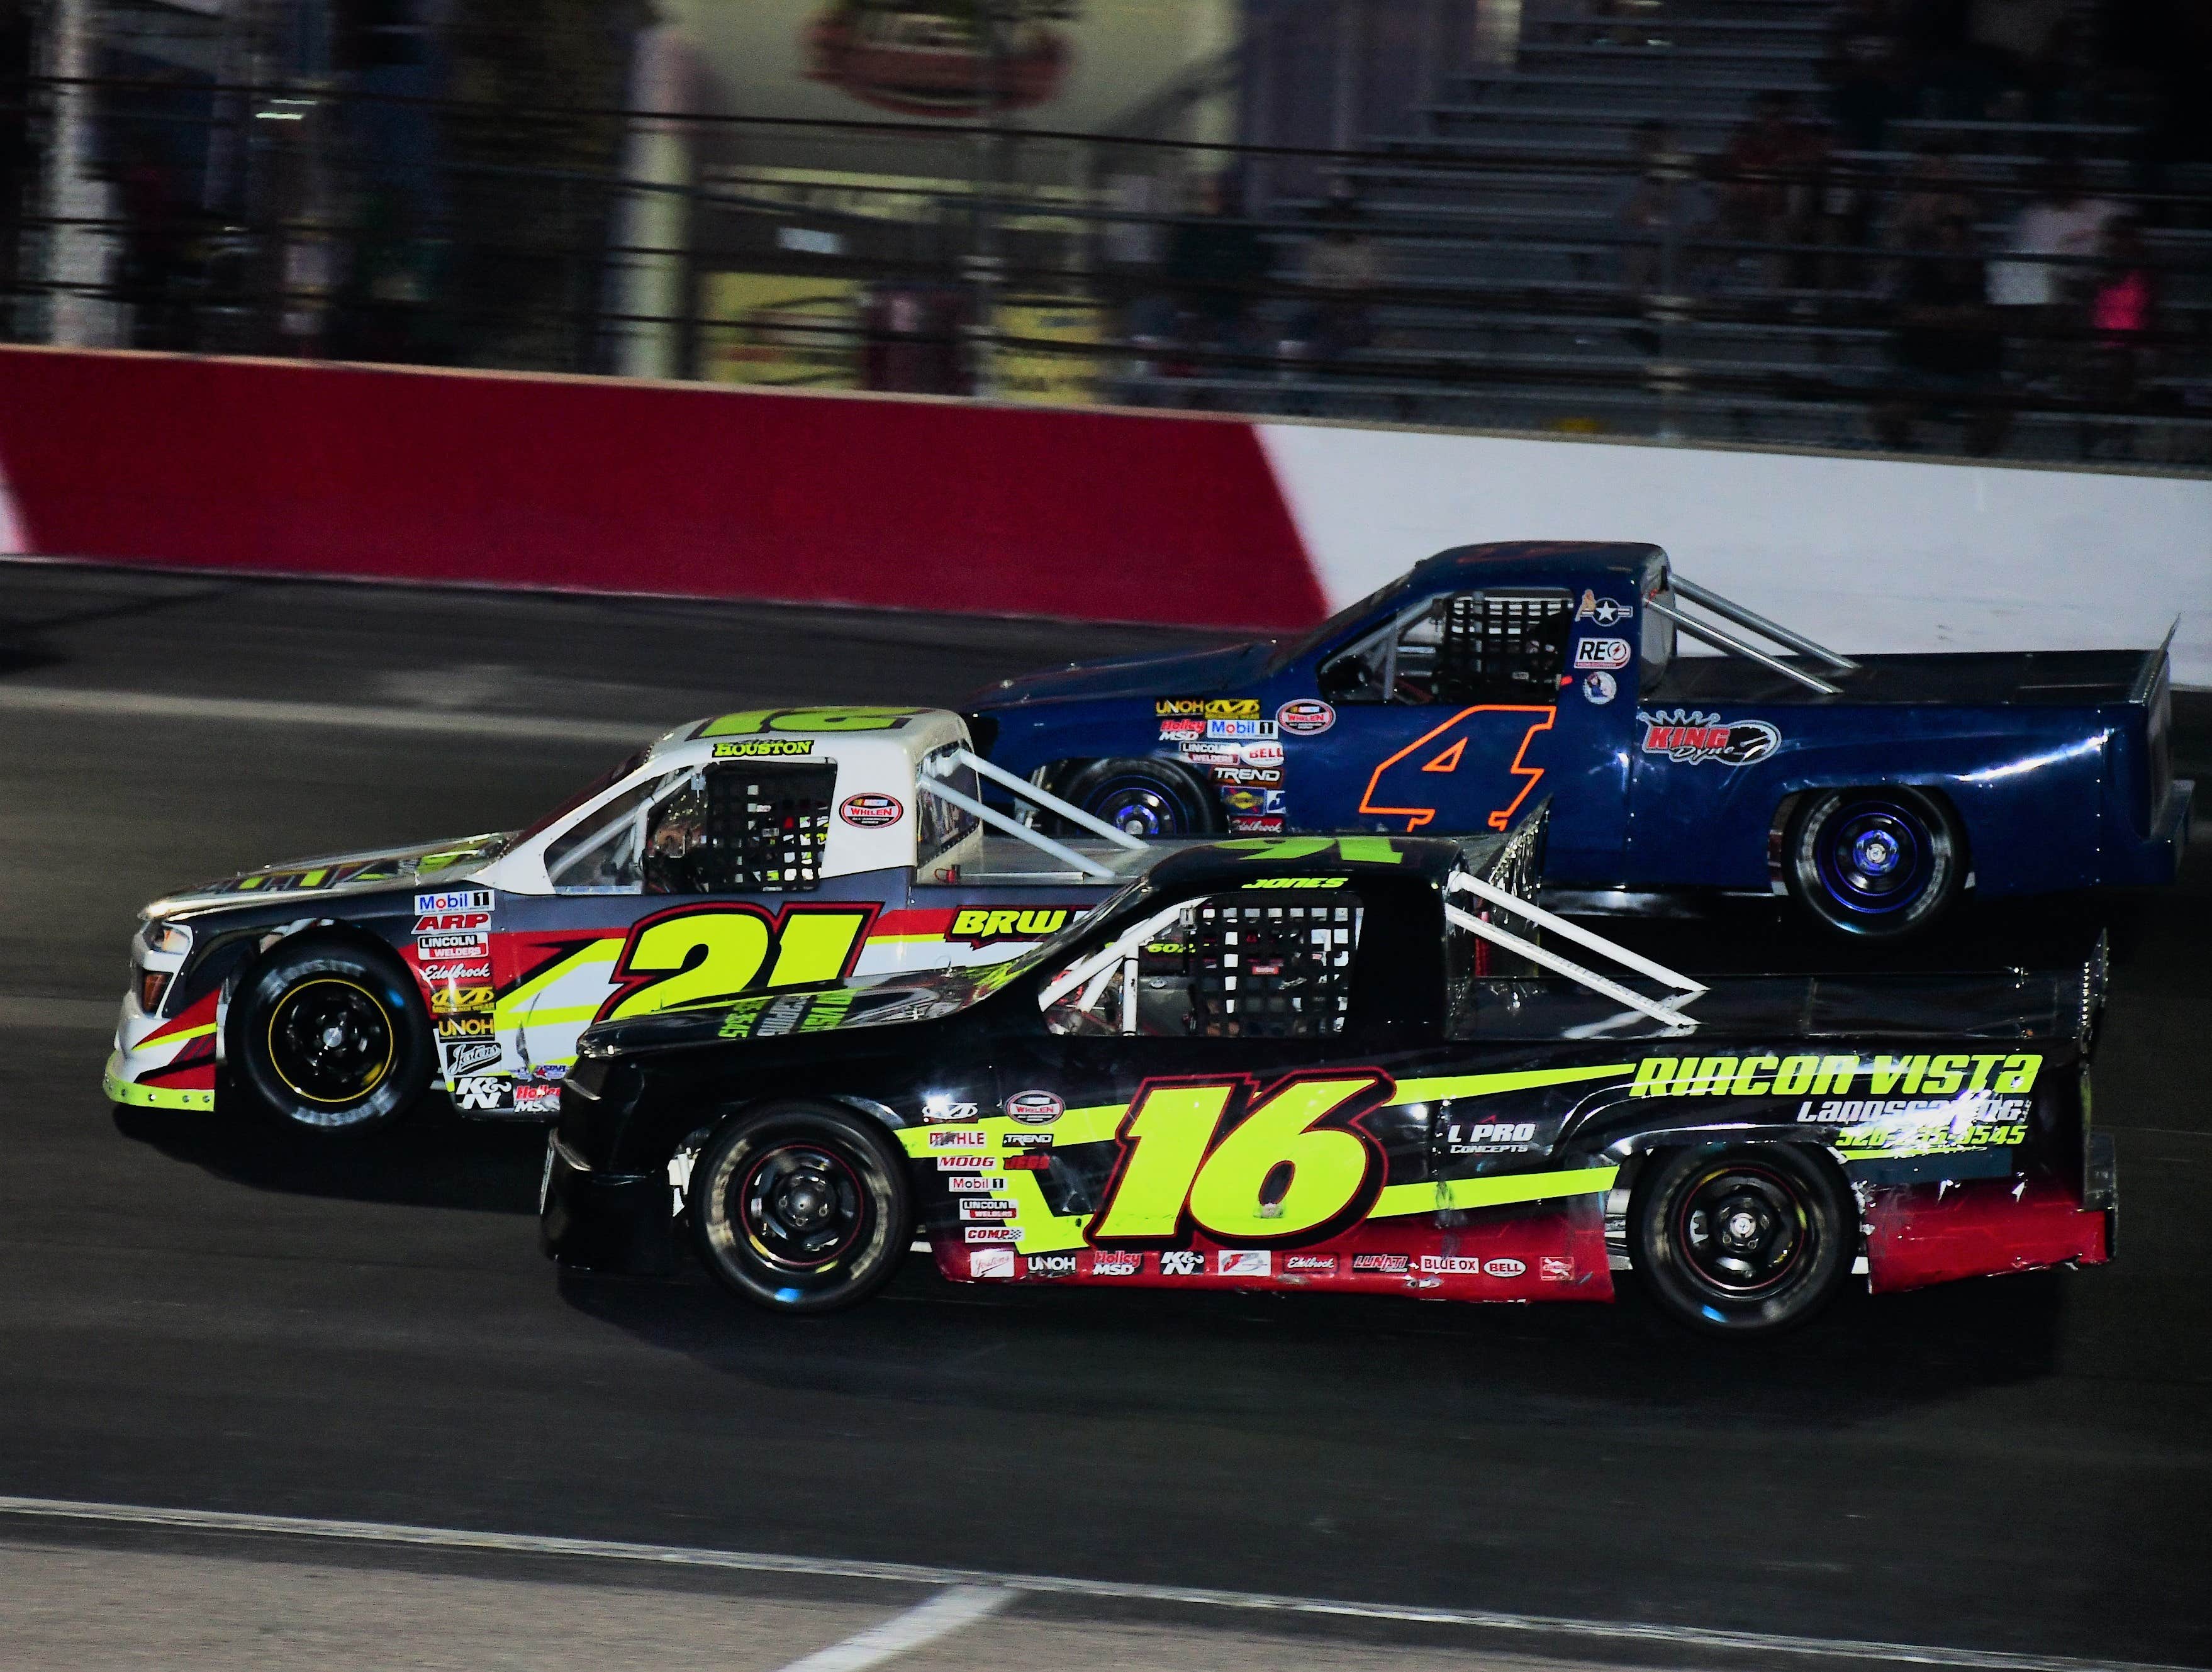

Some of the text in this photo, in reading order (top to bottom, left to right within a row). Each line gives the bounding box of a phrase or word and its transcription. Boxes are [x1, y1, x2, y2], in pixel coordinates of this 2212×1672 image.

[1156, 699, 1204, 713] UNOH
[1212, 720, 1254, 733] Mobil
[1159, 730, 1199, 741] MSD
[1646, 727, 1730, 749] KING
[714, 740, 812, 756] HOUSTON
[1249, 747, 1284, 758] BELL
[1670, 746, 1735, 760] Dyno
[1359, 705, 1557, 832] 4
[1214, 767, 1281, 784] TREND
[851, 808, 893, 816] WHELEN
[1241, 878, 1349, 889] JONES
[420, 893, 467, 910] Mobil
[416, 913, 489, 930] ARP
[952, 910, 1068, 938] BRW
[422, 935, 475, 947] LINCOLN
[434, 947, 482, 957] WELDERS
[423, 962, 491, 980] Edelbrock
[595, 907, 876, 1022] 21
[439, 1018, 494, 1036] UNOH
[1470, 1123, 1536, 1142] PRO
[1005, 1134, 1053, 1146] TREND
[1450, 1144, 1529, 1154] CONCEPTS
[939, 1157, 995, 1167] MOOG
[1092, 1073, 1384, 1242] 16
[953, 1178, 988, 1188] Mobil
[963, 1201, 1008, 1209] LINCOLN
[968, 1230, 1010, 1239] COMP
[1027, 1256, 1076, 1271] UNOH
[1095, 1250, 1143, 1268] Holley
[1287, 1257, 1334, 1269] Edelbrock
[1424, 1259, 1476, 1271] BLUE OX
[1093, 1264, 1135, 1276] MSD
[1489, 1263, 1521, 1272] BELL
